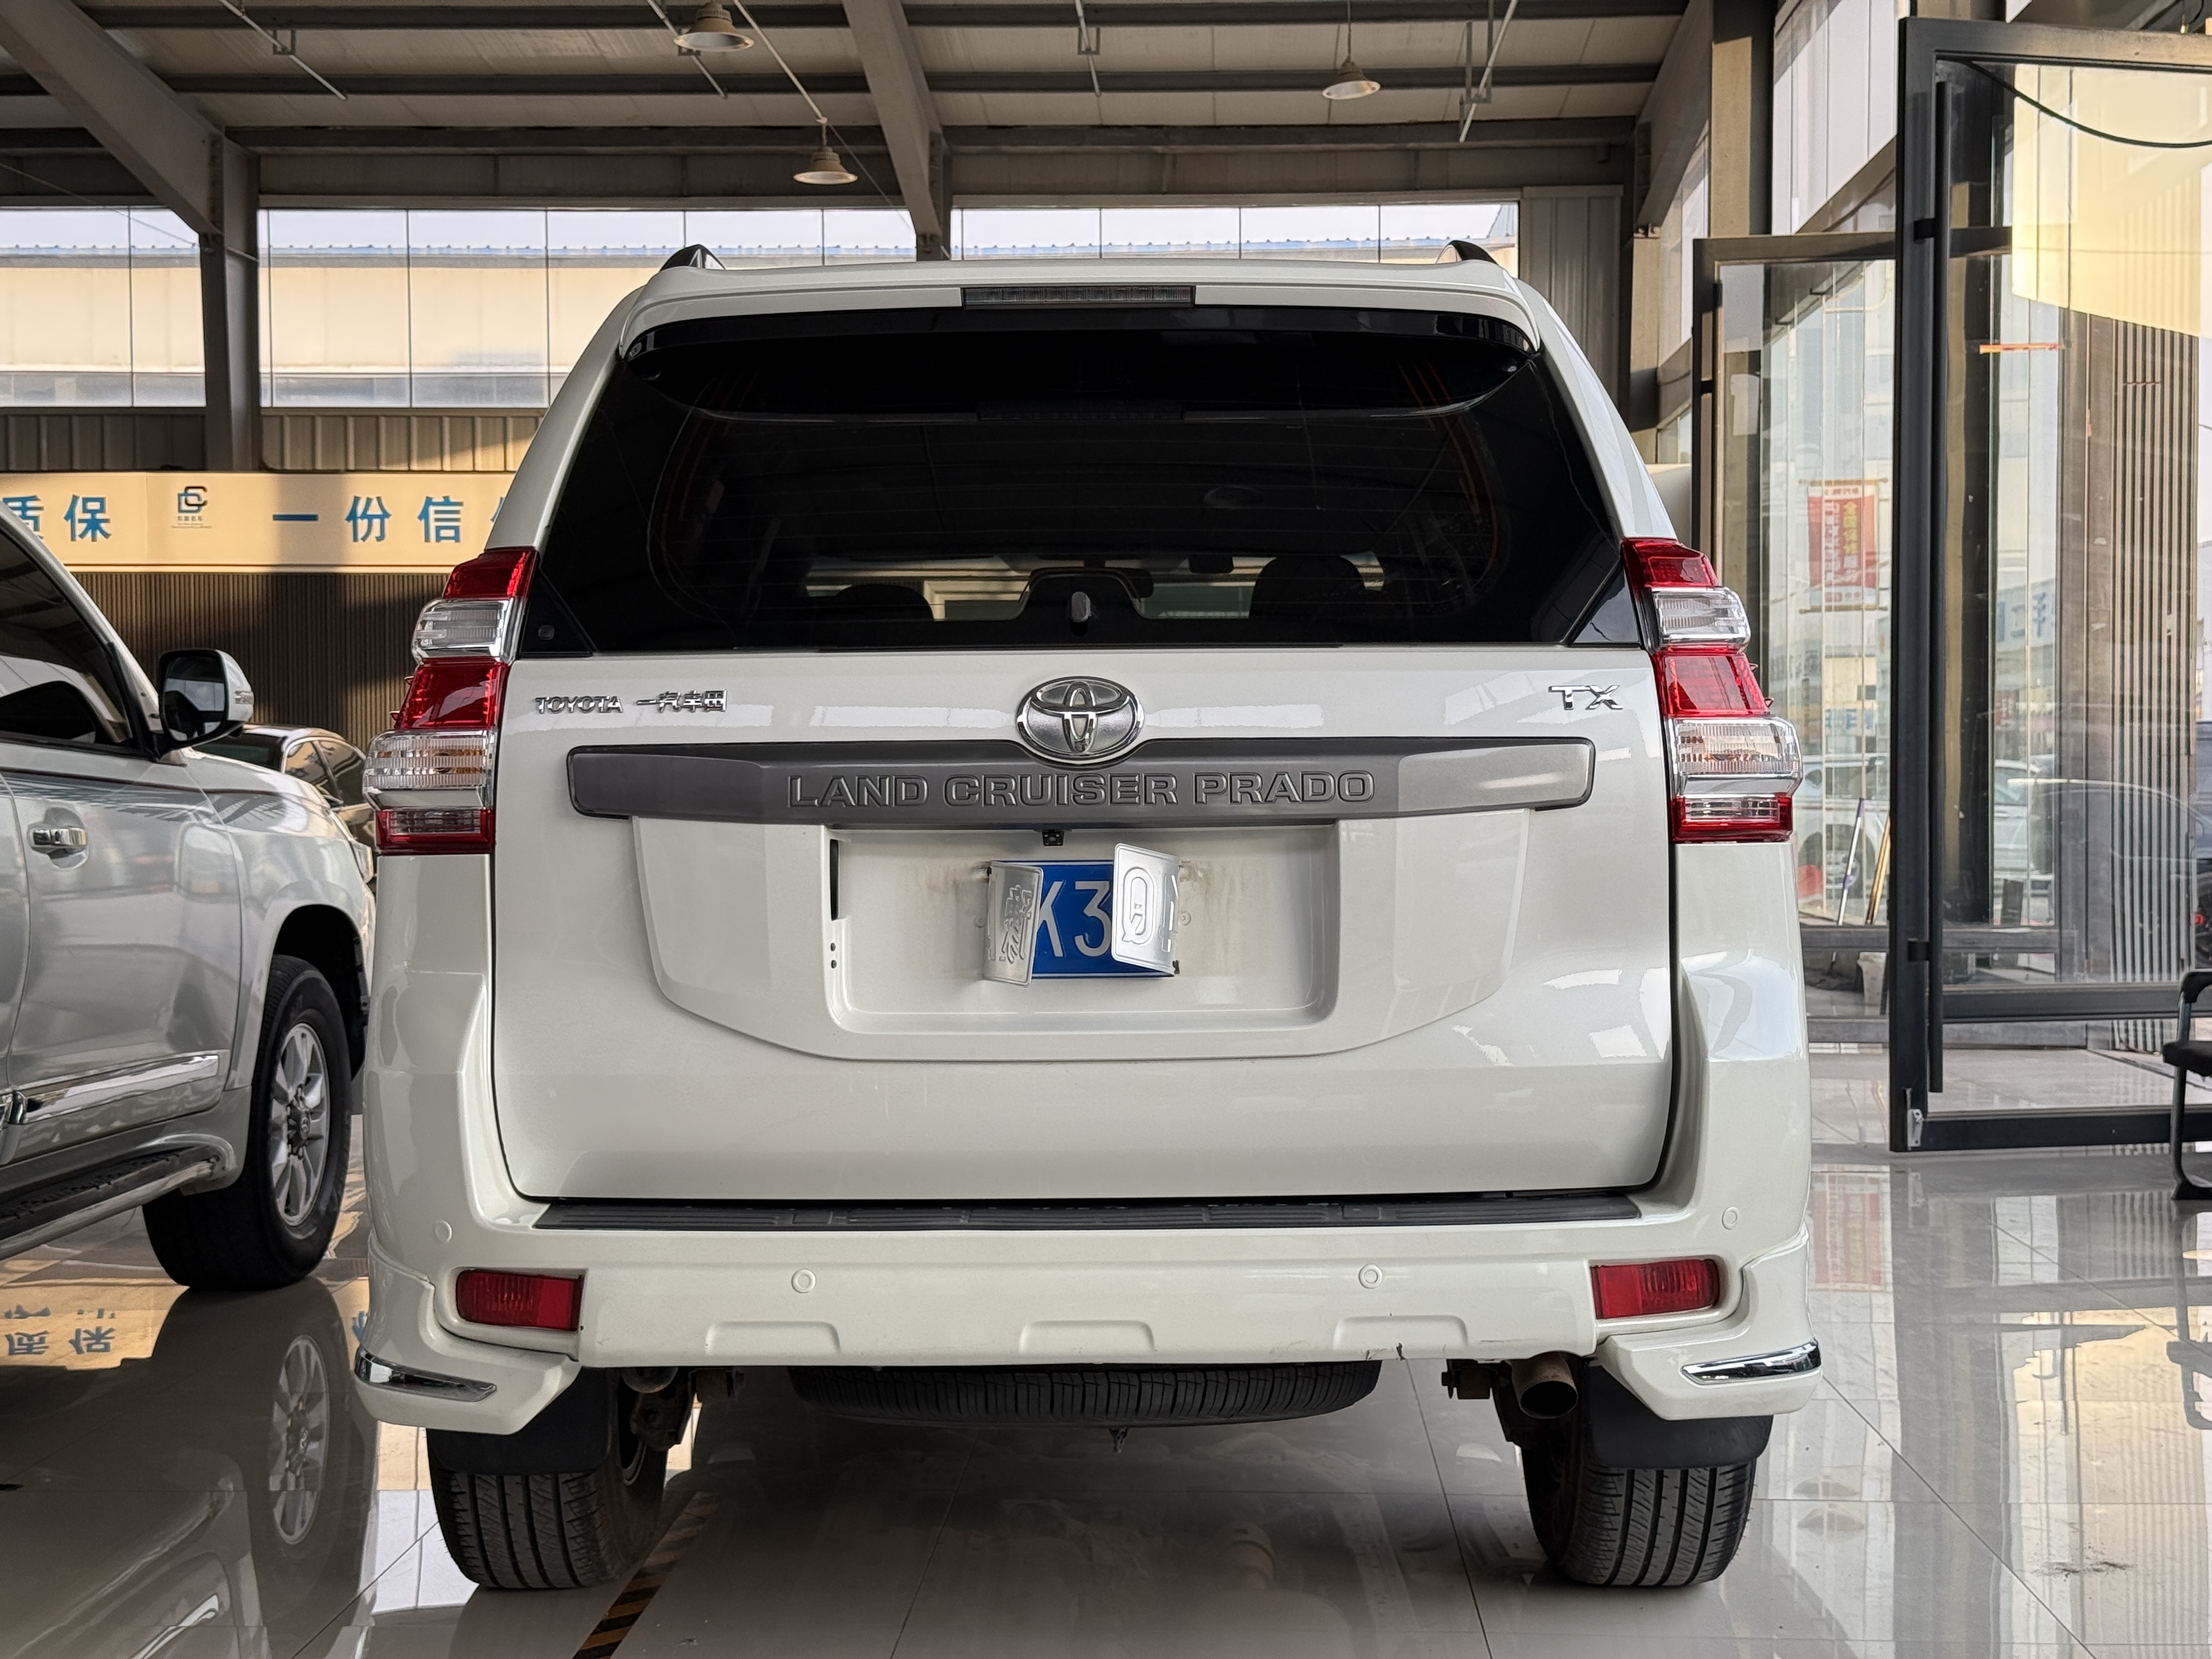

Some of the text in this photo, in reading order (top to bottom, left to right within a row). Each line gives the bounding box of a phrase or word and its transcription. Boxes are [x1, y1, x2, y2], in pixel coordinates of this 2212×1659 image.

[273, 495, 504, 543] 一份信
[535, 695, 624, 713] TOYOTA
[636, 689, 727, 713] 一汽丰田
[1548, 685, 1623, 710] TX
[788, 770, 1374, 808] LAND CRUISER PRADO
